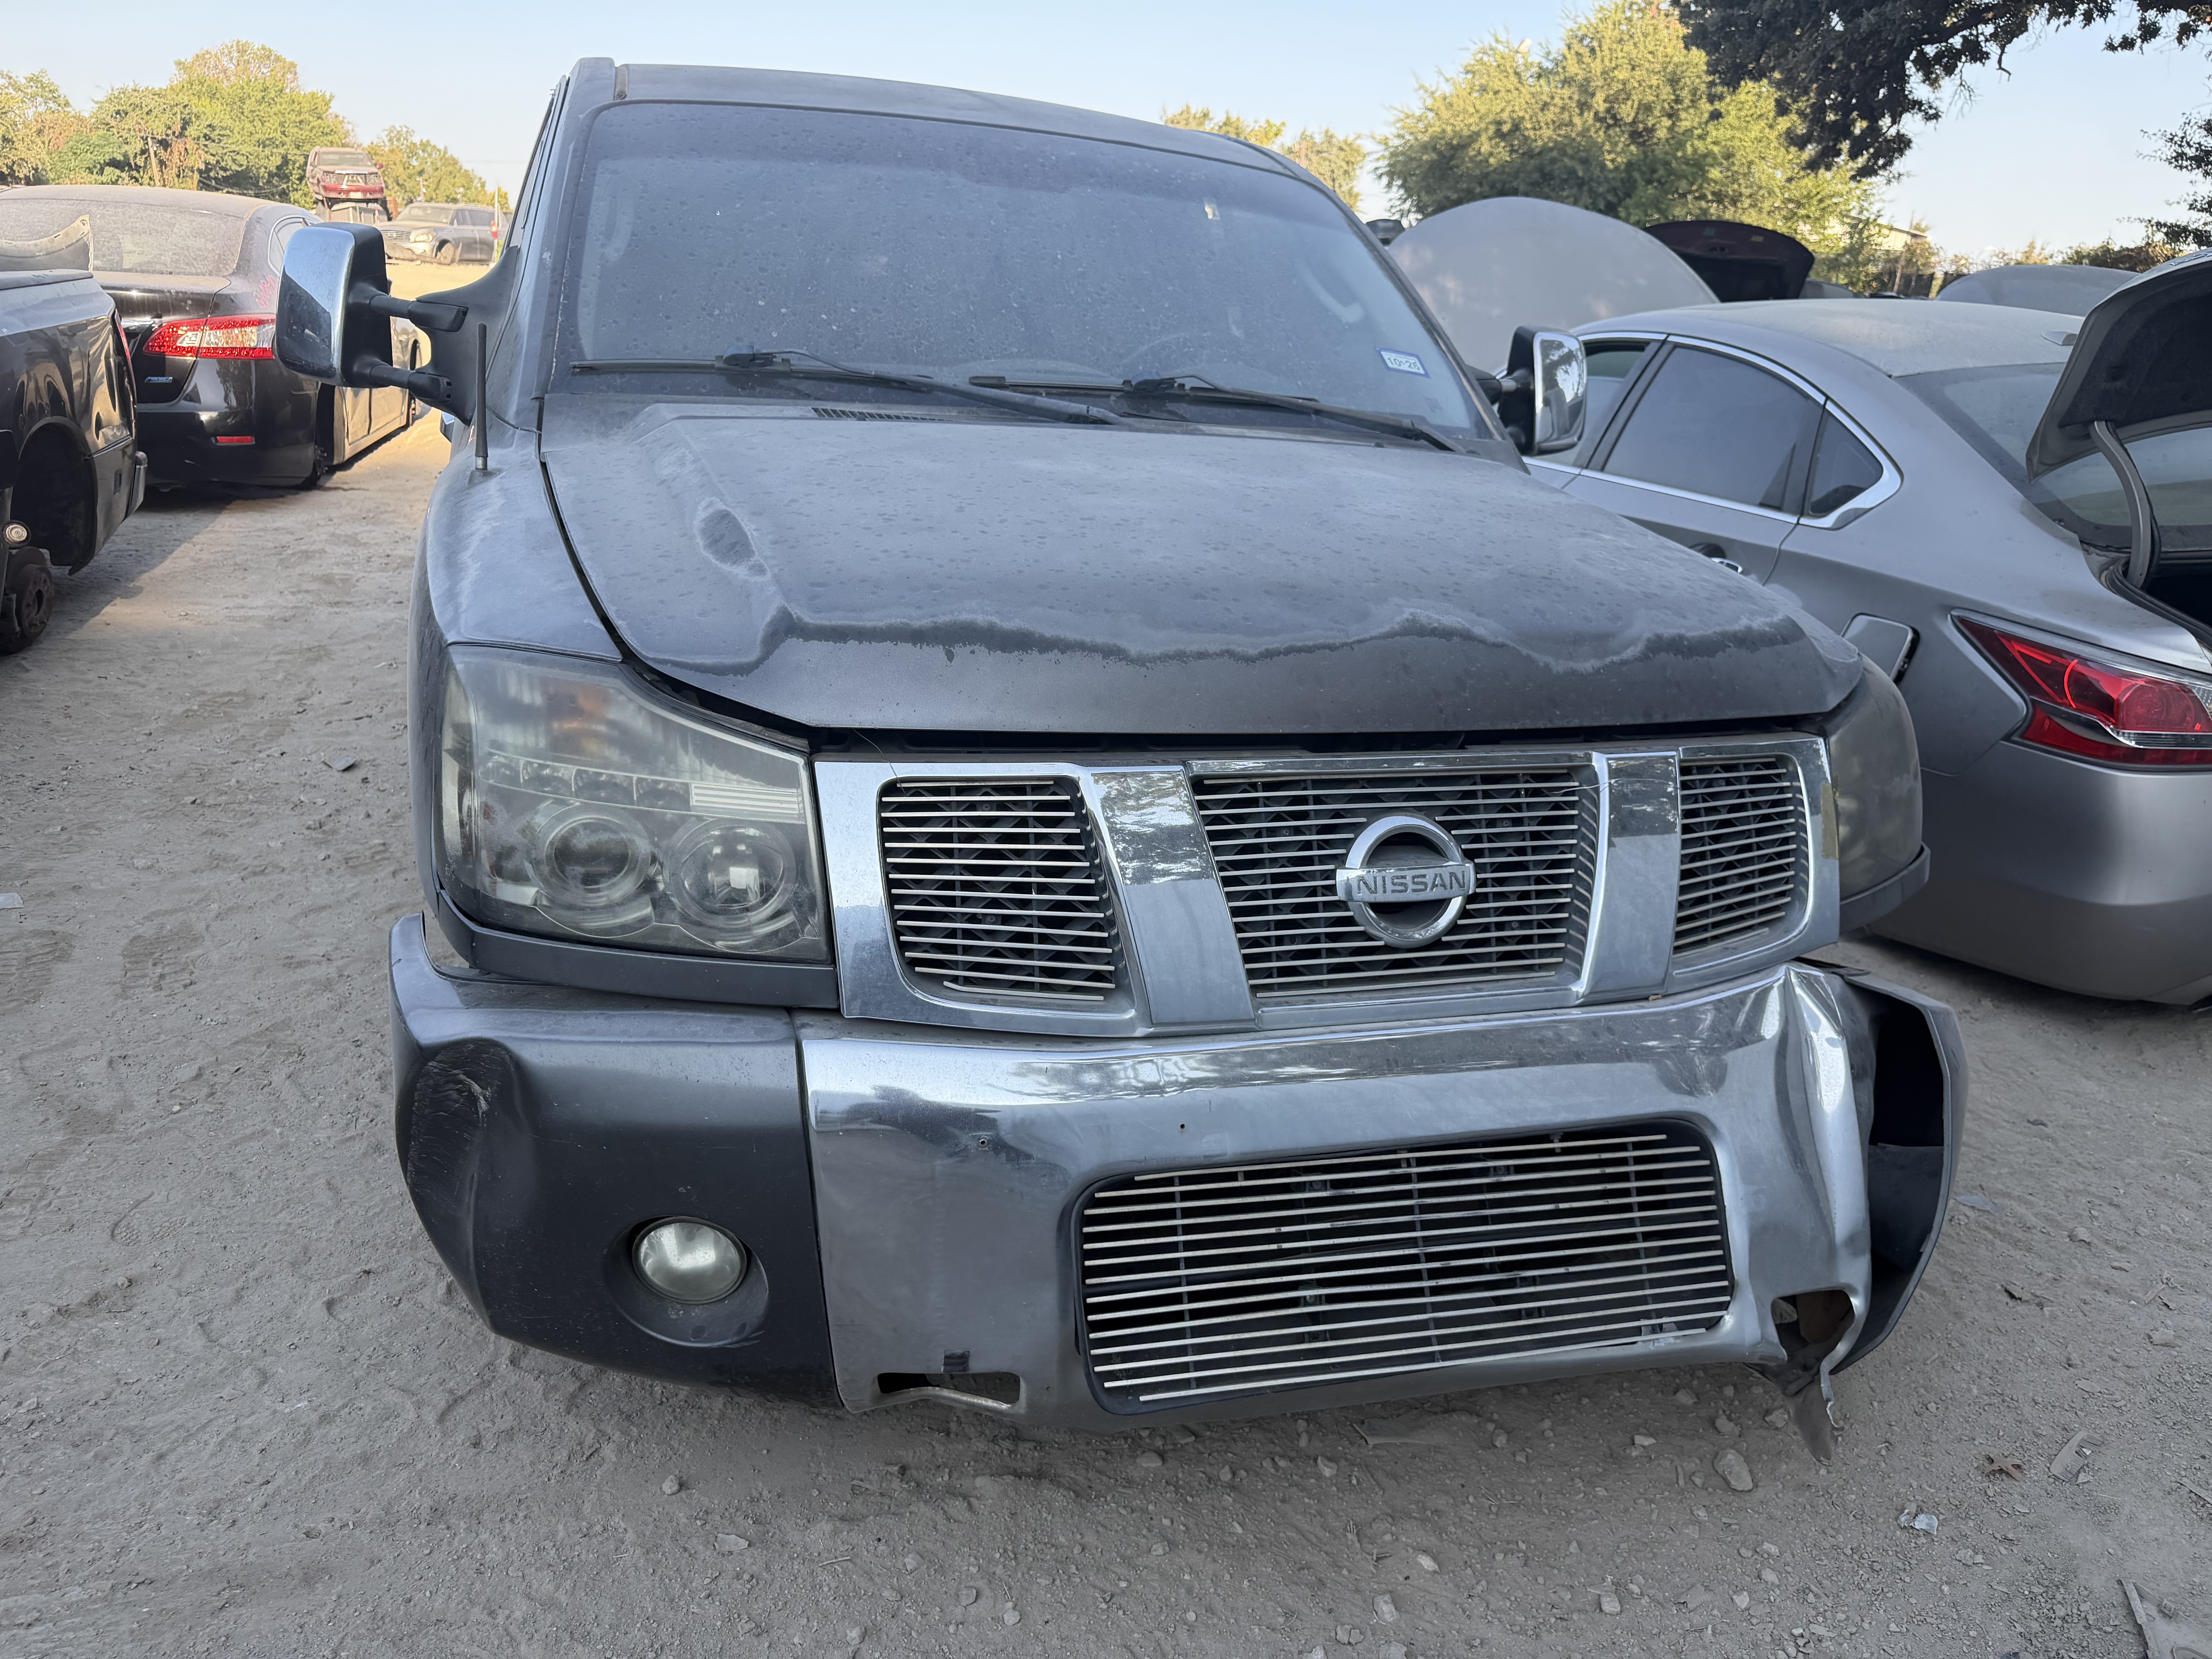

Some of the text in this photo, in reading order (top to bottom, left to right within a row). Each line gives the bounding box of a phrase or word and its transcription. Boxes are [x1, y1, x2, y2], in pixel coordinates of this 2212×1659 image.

[1387, 357, 1420, 370] 10 26
[1357, 871, 1466, 895] NISSAN
